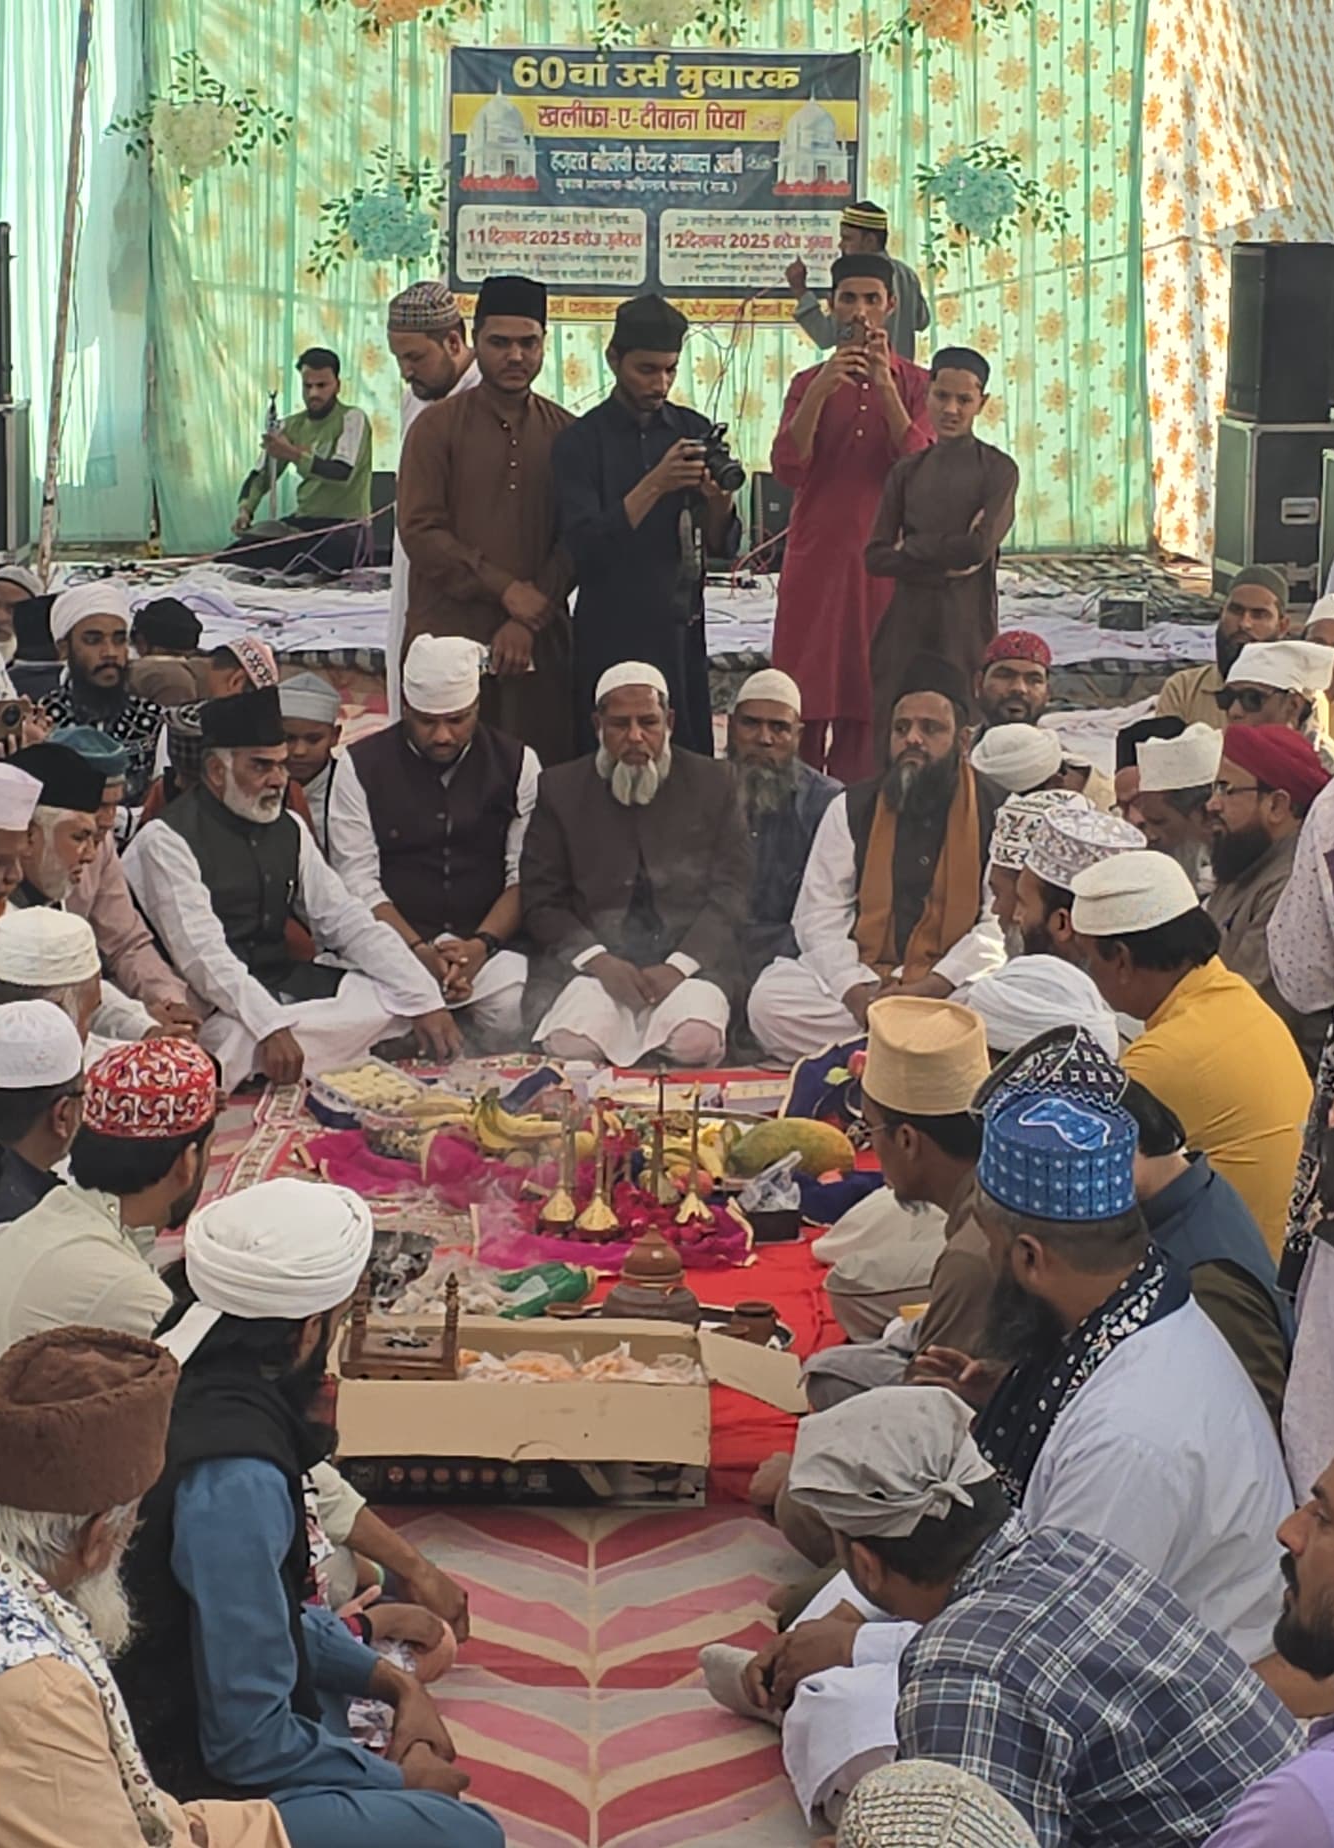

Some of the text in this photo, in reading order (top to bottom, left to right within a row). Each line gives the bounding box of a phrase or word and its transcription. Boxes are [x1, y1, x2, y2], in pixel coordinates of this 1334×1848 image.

[512, 54, 801, 98] 60वां उर्स मुबारक
[706, 102, 747, 130] पिया
[468, 229, 486, 245] 11
[529, 230, 571, 246] 2025
[665, 232, 684, 249] 12
[729, 233, 770, 249] 2025
